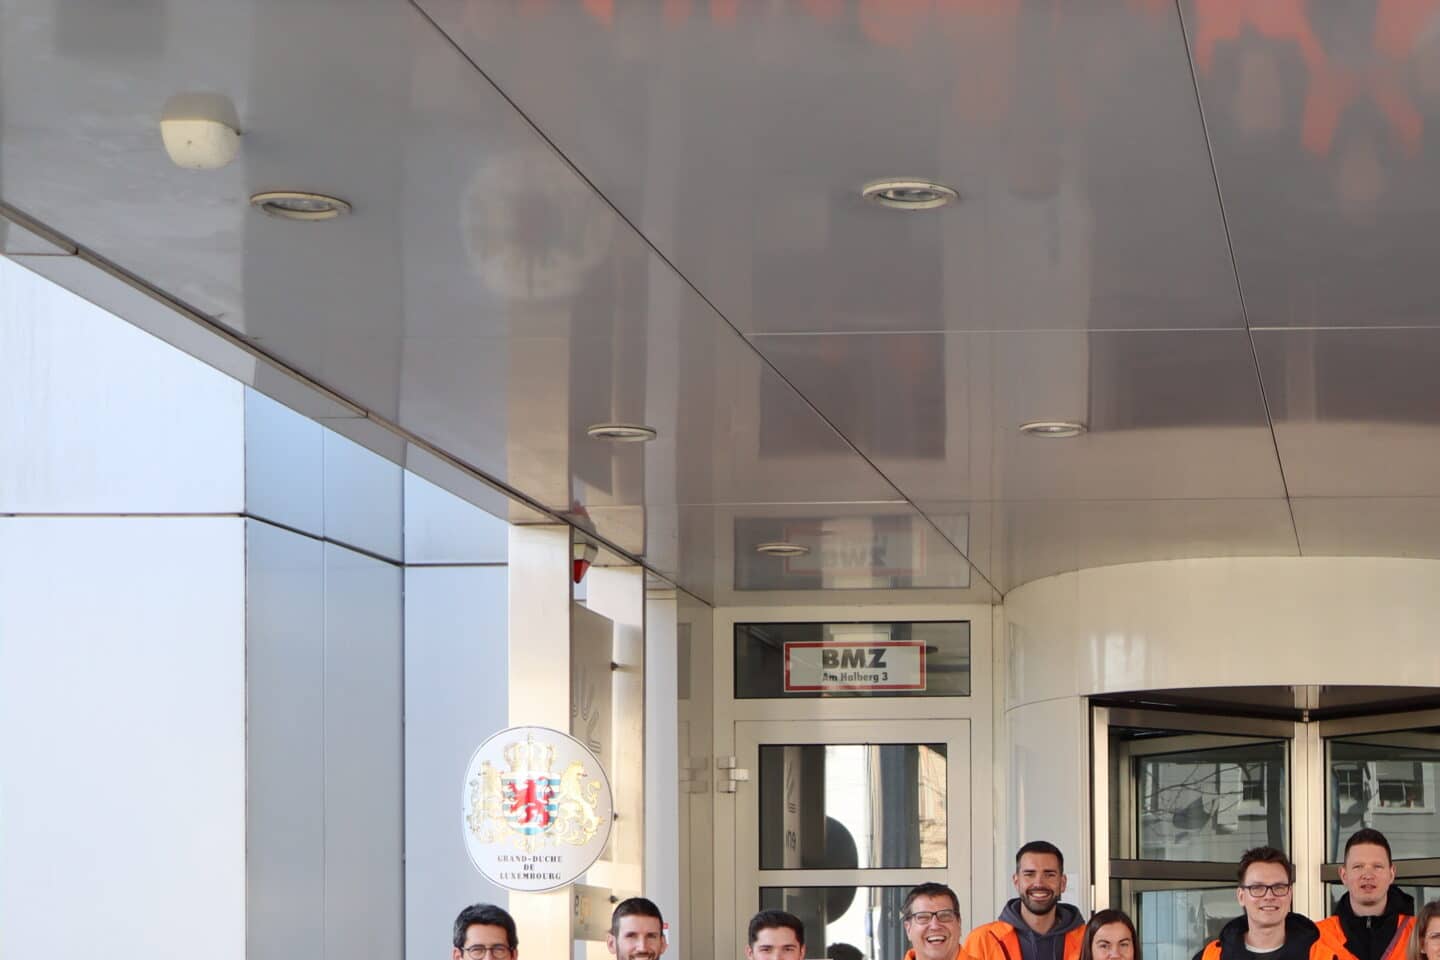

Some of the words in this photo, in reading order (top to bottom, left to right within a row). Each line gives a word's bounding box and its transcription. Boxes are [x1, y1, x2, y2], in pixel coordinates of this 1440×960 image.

[822, 648, 887, 669] BMZ
[822, 672, 838, 681] Am
[840, 671, 879, 683] Halberg
[881, 671, 888, 681] 3
[523, 863, 535, 871] DE
[500, 872, 561, 880] LUXEMBOURG
